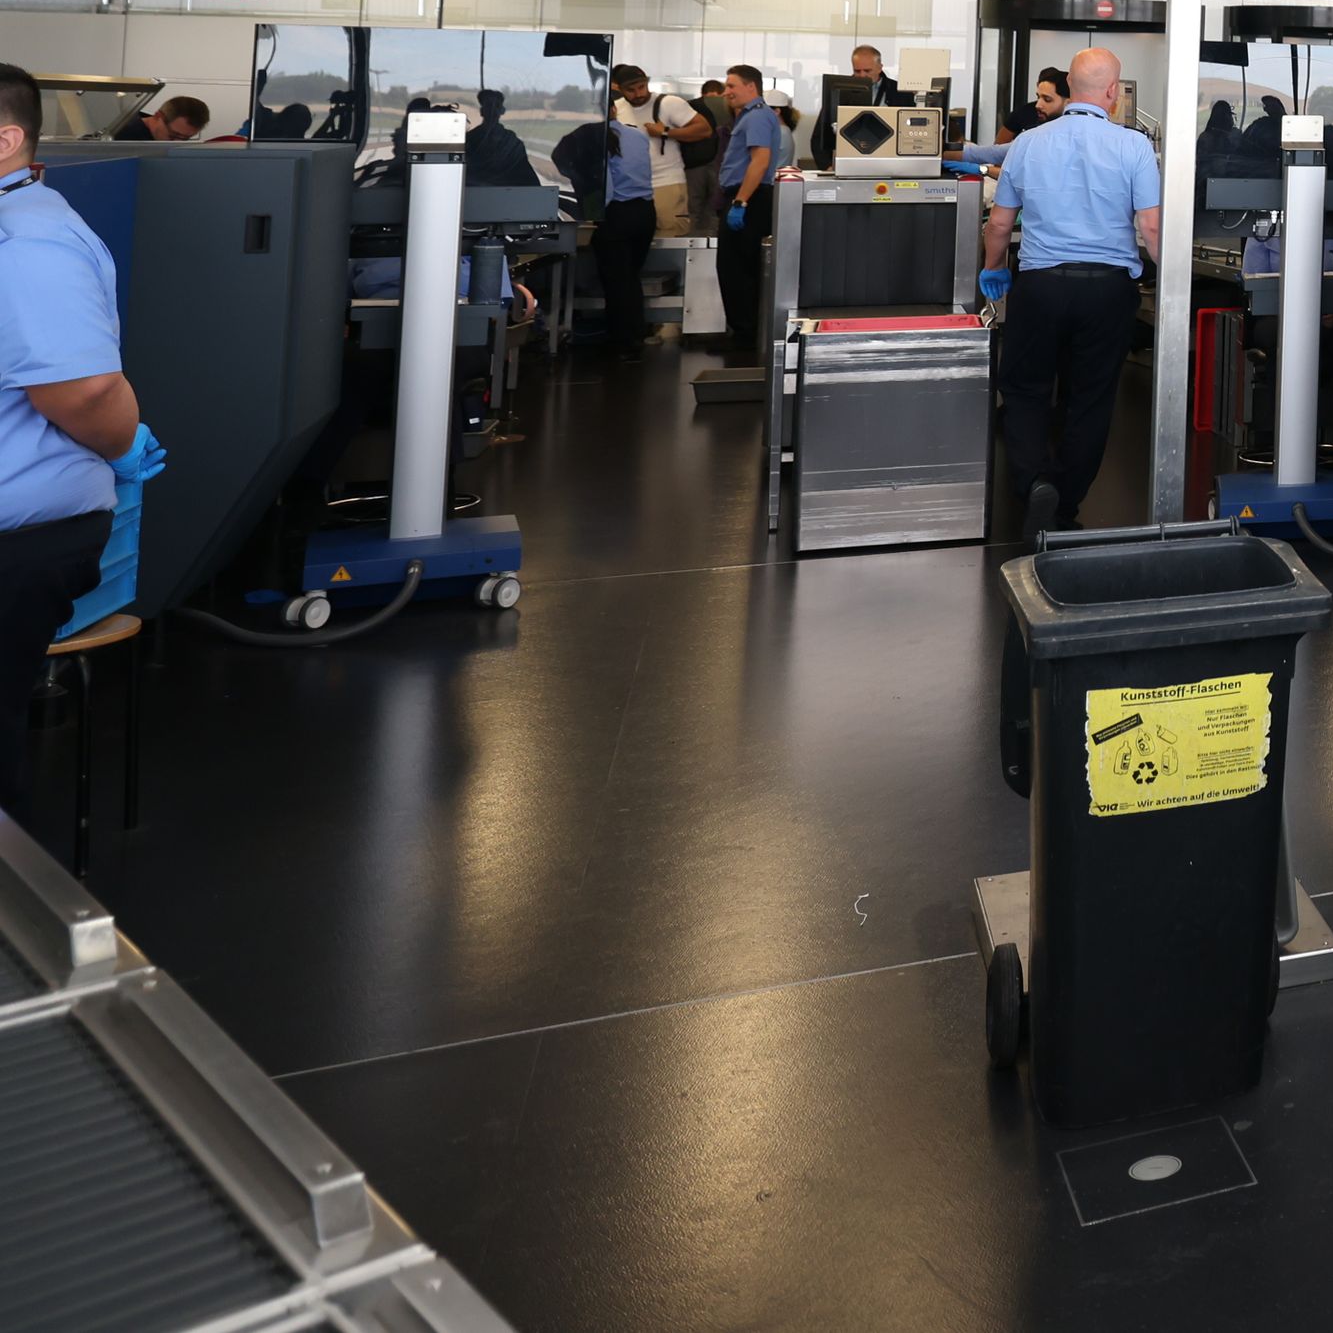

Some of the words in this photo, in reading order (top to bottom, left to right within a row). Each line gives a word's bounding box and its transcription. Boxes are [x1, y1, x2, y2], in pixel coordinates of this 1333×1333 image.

[925, 186, 956, 194] smiths
[1120, 681, 1242, 702] Kunststoff-Flaschen
[1219, 712, 1247, 720] Flaschen
[1211, 718, 1256, 729] Verpackungen
[1216, 725, 1250, 735] Kunststoff
[1199, 770, 1219, 779] gehört
[1155, 795, 1188, 805] achten
[1190, 792, 1205, 801] auf
[1207, 790, 1220, 798] die
[1222, 783, 1260, 796] Umwelt!
